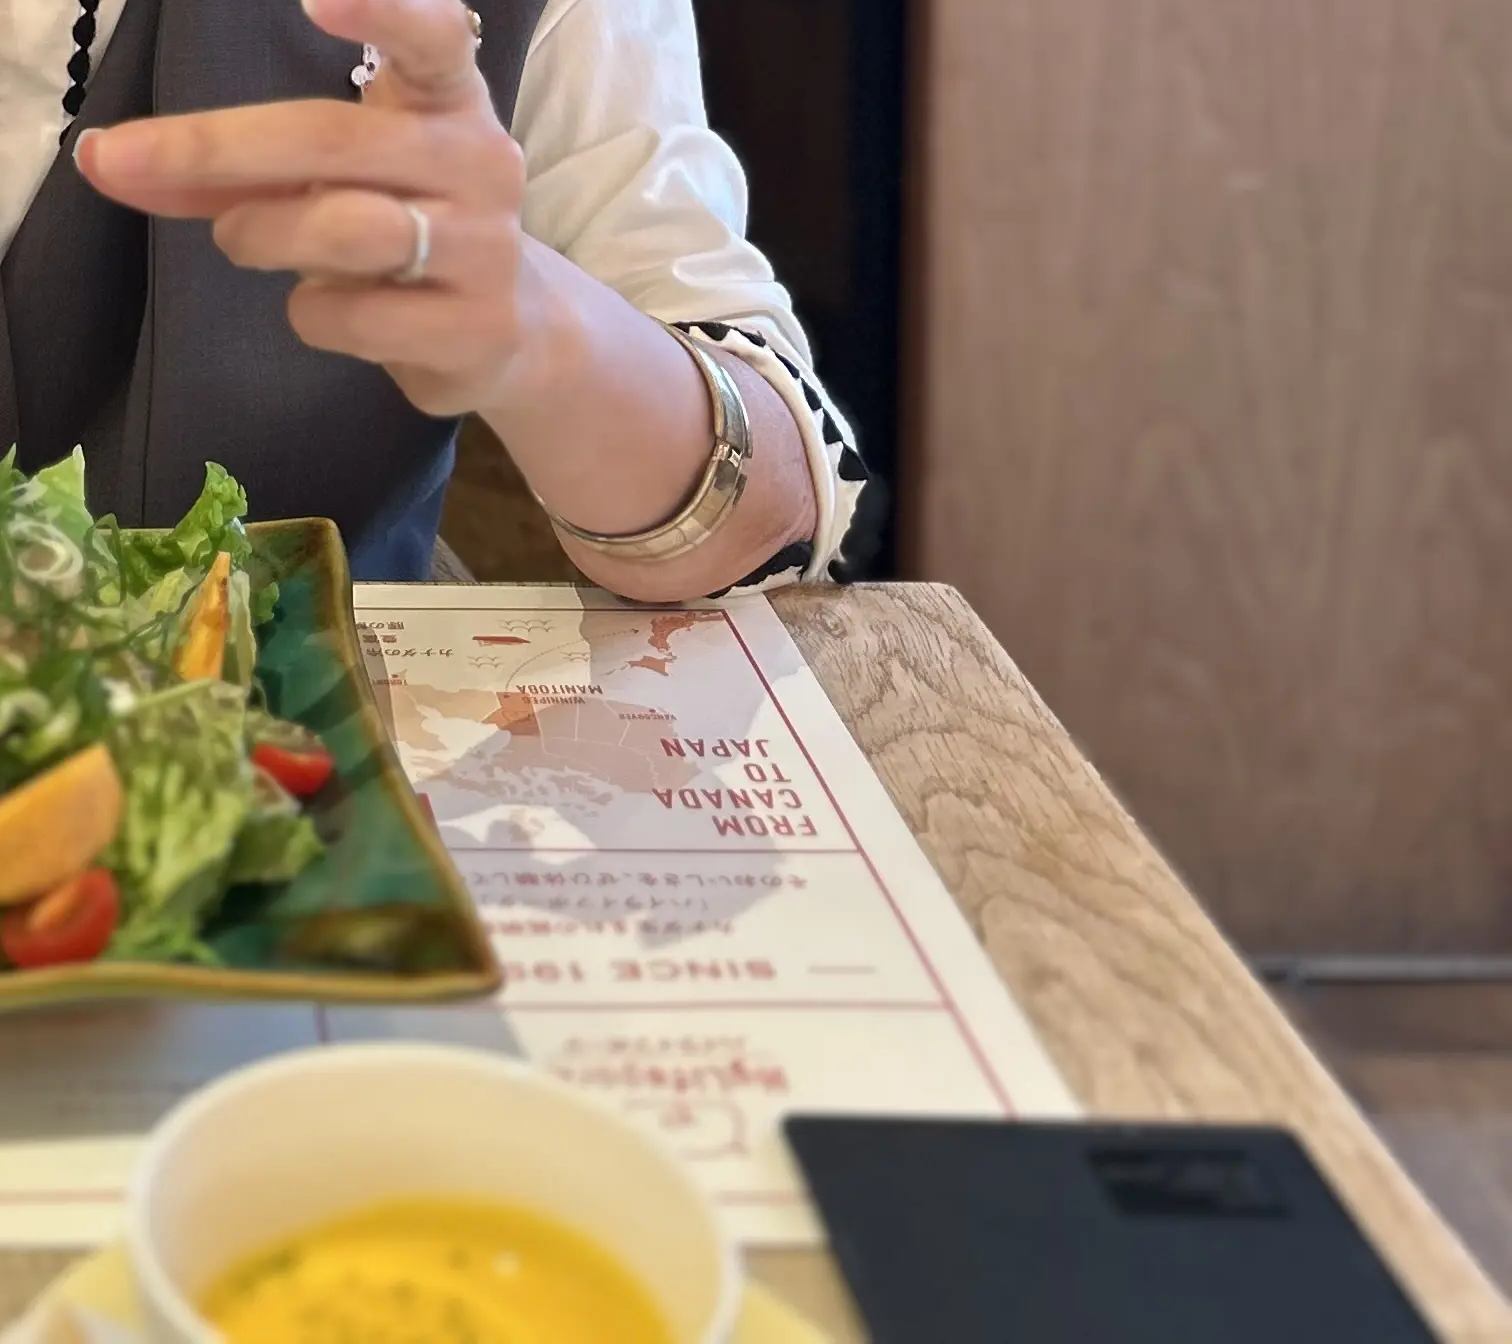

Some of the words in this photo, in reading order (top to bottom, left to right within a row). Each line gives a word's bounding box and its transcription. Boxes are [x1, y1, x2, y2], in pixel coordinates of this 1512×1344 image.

[515, 684, 604, 695] MANITOBA
[521, 696, 586, 705] WINNIPEG
[659, 738, 770, 758] JAPAN
[743, 763, 792, 783] TO
[651, 788, 803, 809] CANADA
[711, 815, 818, 837] FROM
[461, 872, 807, 889] そのおいしさを、ぜひ体験して
[612, 960, 776, 982] SINCE
